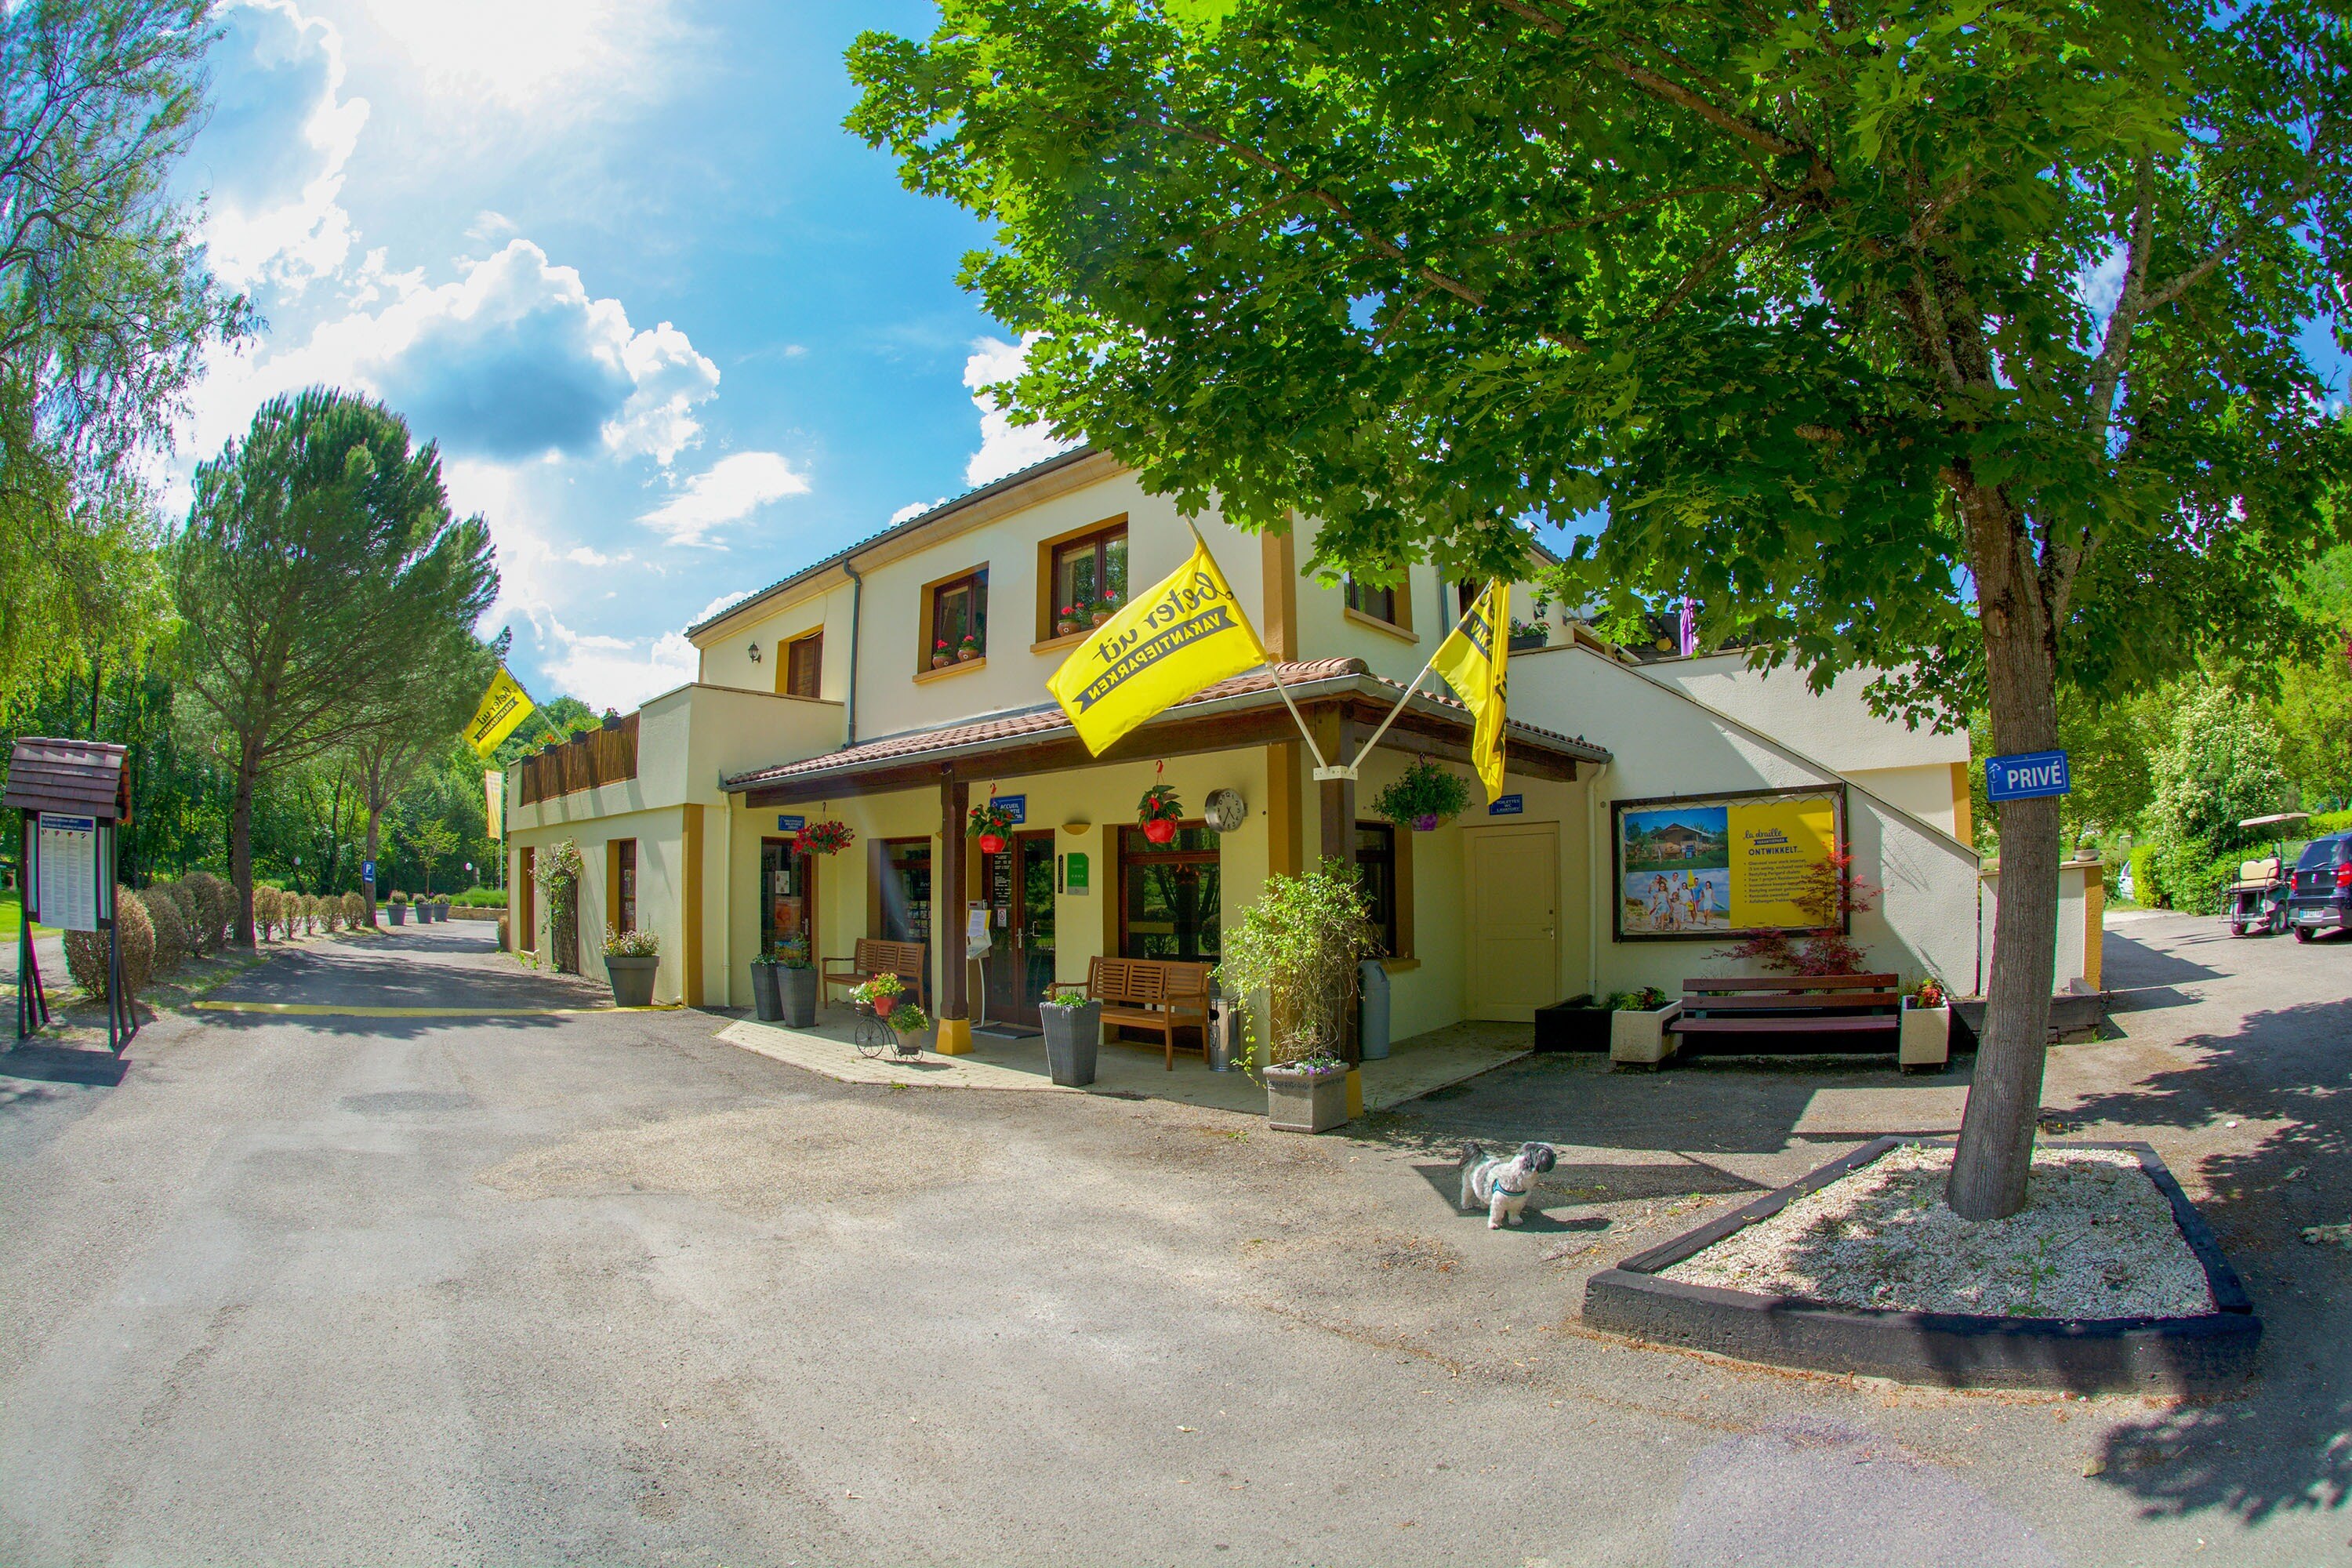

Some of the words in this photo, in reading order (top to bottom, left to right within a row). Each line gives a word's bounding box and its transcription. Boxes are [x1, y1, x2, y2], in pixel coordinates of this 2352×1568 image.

[2007, 760, 2062, 789] PRIVÉ
[1744, 829, 1754, 840] la
[1756, 828, 1782, 838] draille
[366, 864, 372, 873] P
